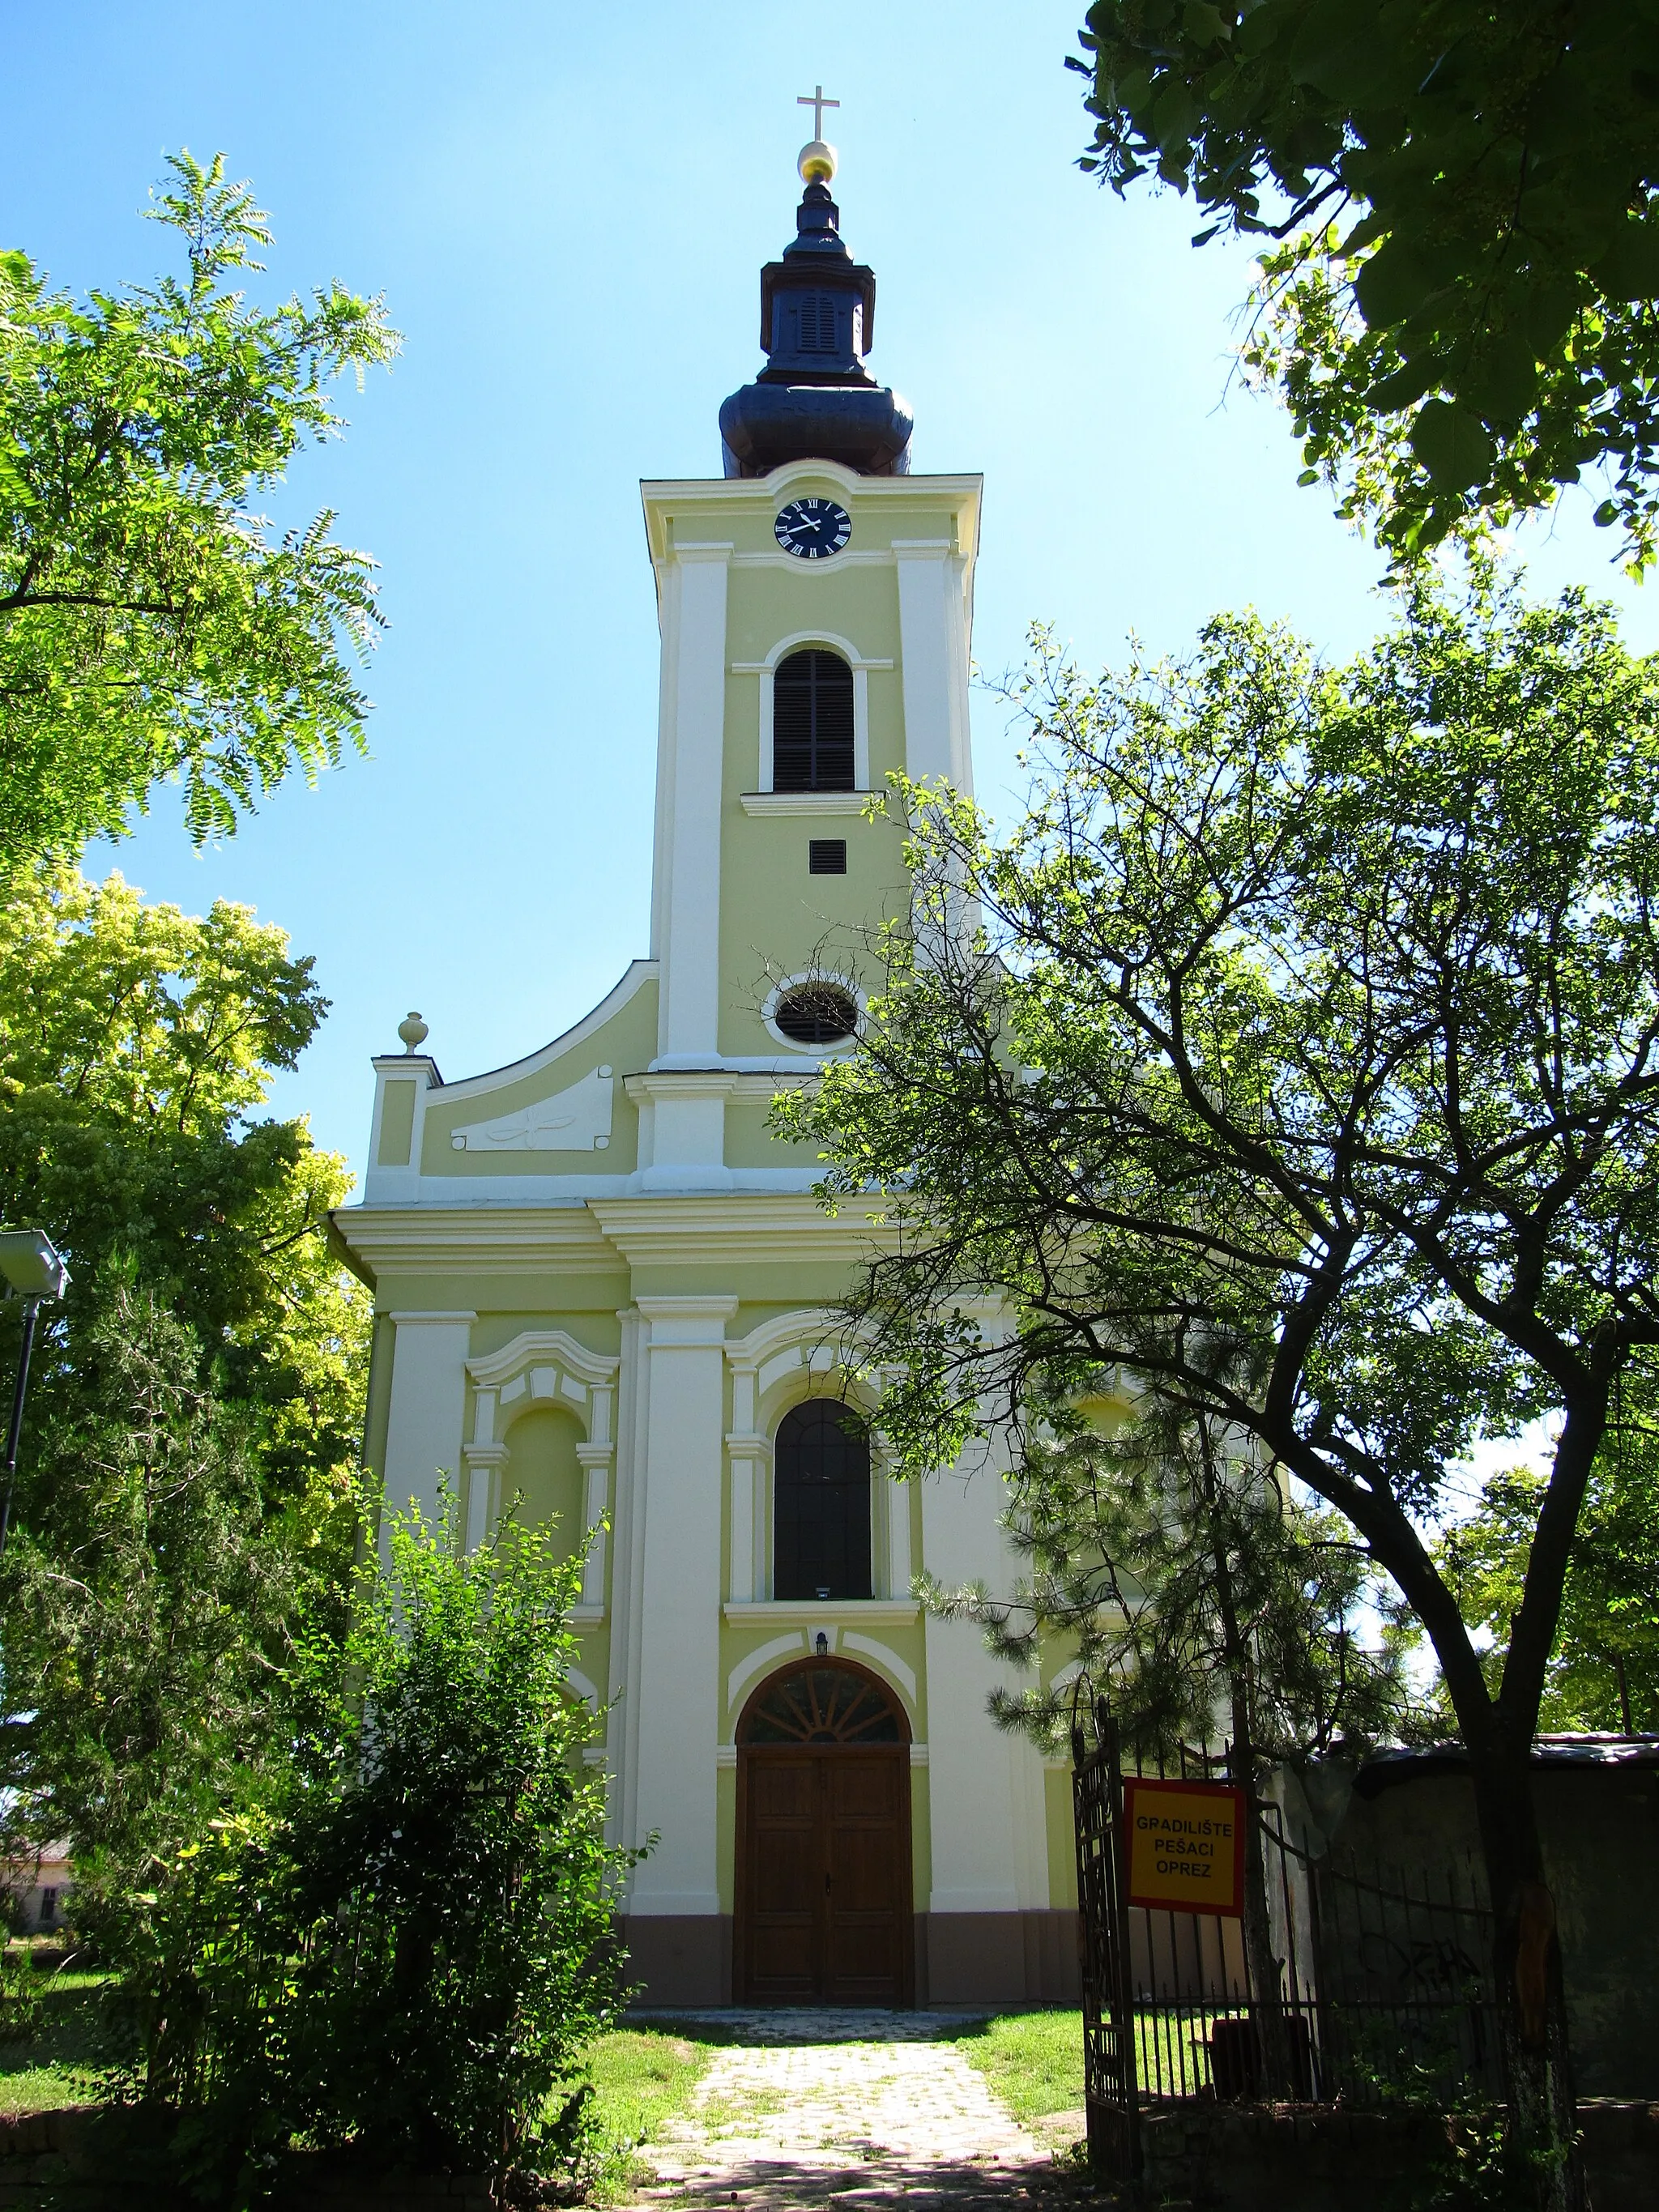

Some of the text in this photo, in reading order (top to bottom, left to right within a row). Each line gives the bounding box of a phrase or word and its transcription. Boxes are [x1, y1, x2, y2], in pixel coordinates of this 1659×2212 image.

[808, 499, 818, 509] XII
[1137, 1816, 1232, 1837] GRADILIŠTE
[1154, 1838, 1213, 1856] PEŠACI
[1157, 1860, 1212, 1878] OPREZ
